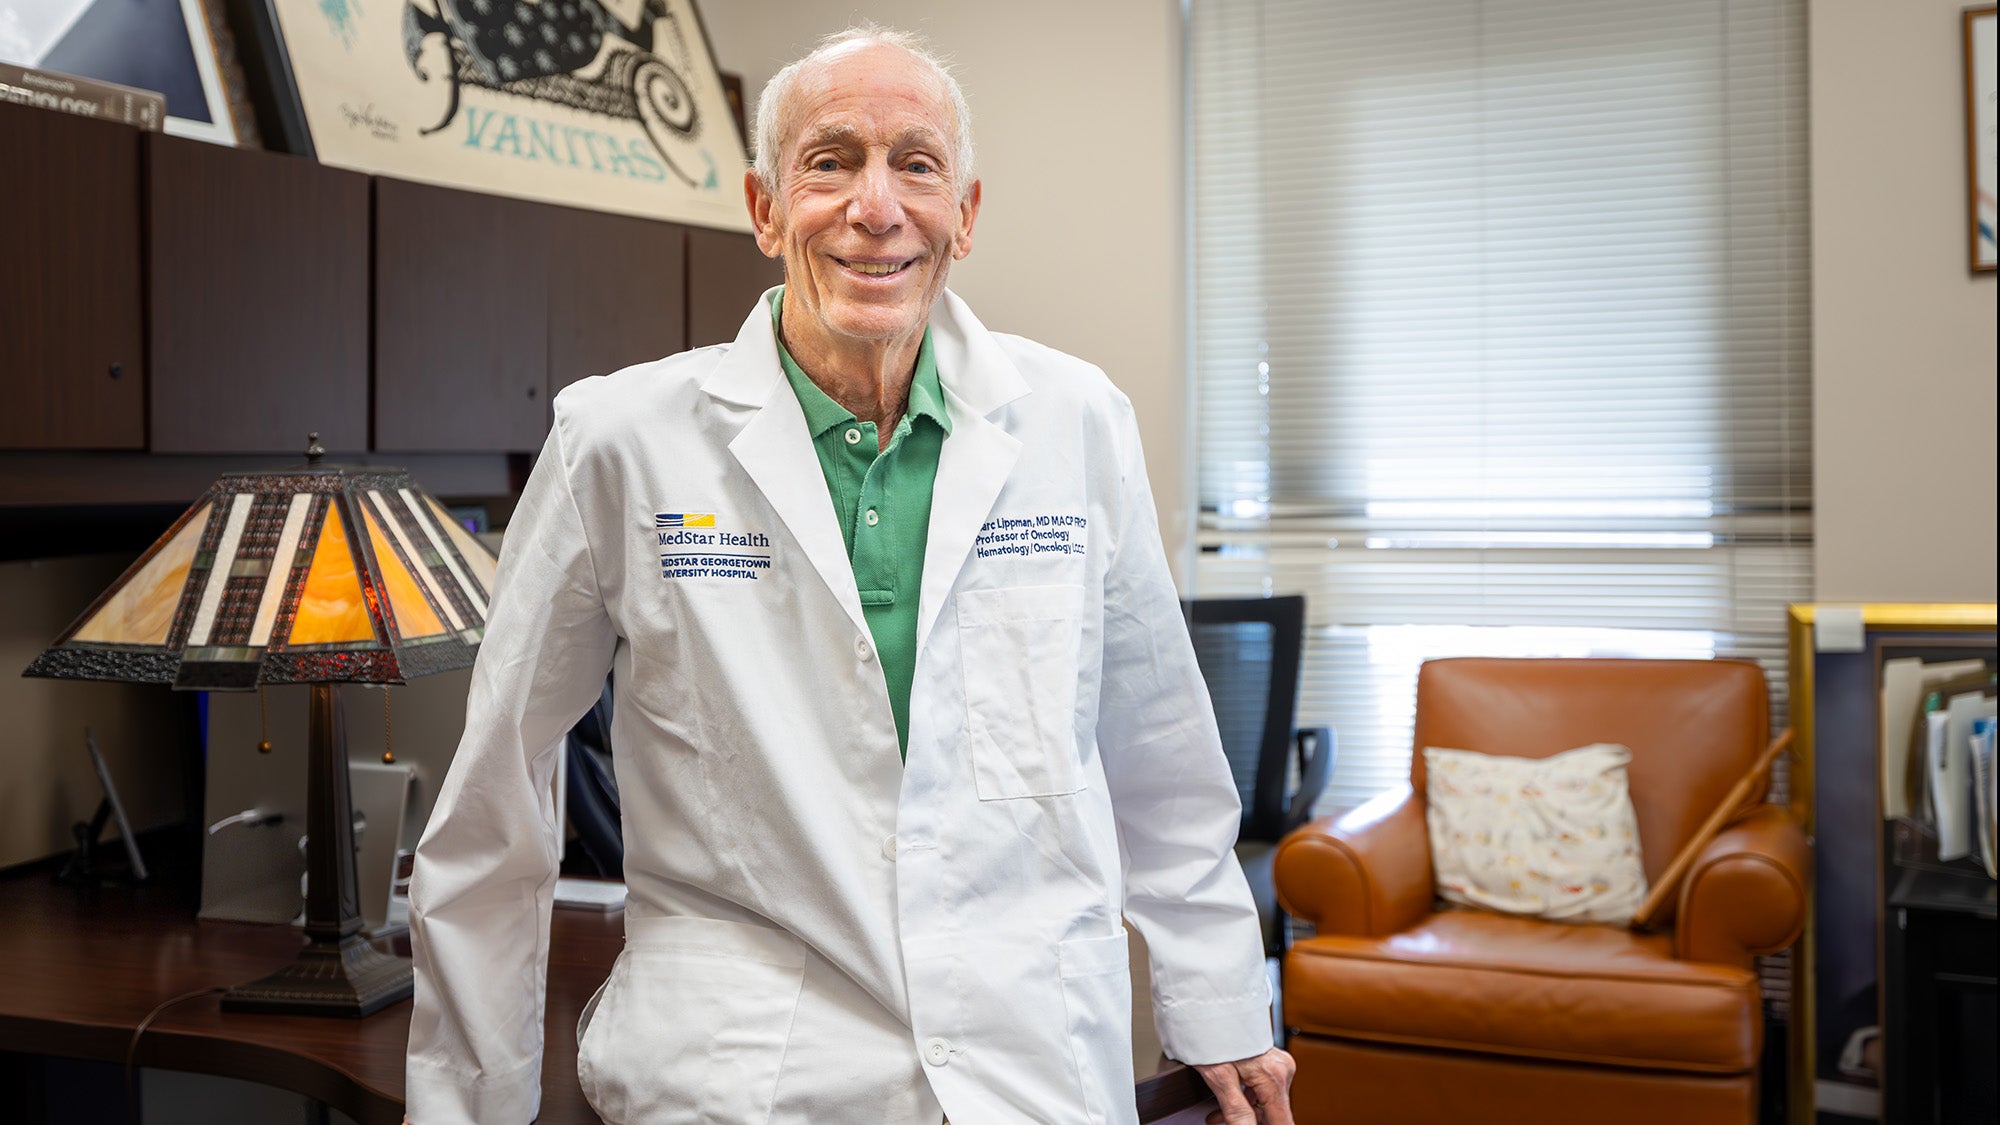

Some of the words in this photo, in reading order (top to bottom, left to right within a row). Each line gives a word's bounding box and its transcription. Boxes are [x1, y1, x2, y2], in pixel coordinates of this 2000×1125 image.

[464, 106, 667, 182] VANITAS
[980, 521, 996, 532] arc
[997, 518, 1035, 530] Lippman,
[1036, 516, 1050, 527] MD
[658, 531, 715, 546] MedStar
[719, 532, 770, 547] Health
[975, 532, 1018, 546] Professor
[1020, 529, 1029, 540] of
[1030, 528, 1070, 541] Oncology
[661, 557, 698, 568] MEDSTAR
[700, 557, 771, 569] GEORGETOWN
[711, 568, 758, 580] HOSPITAL
